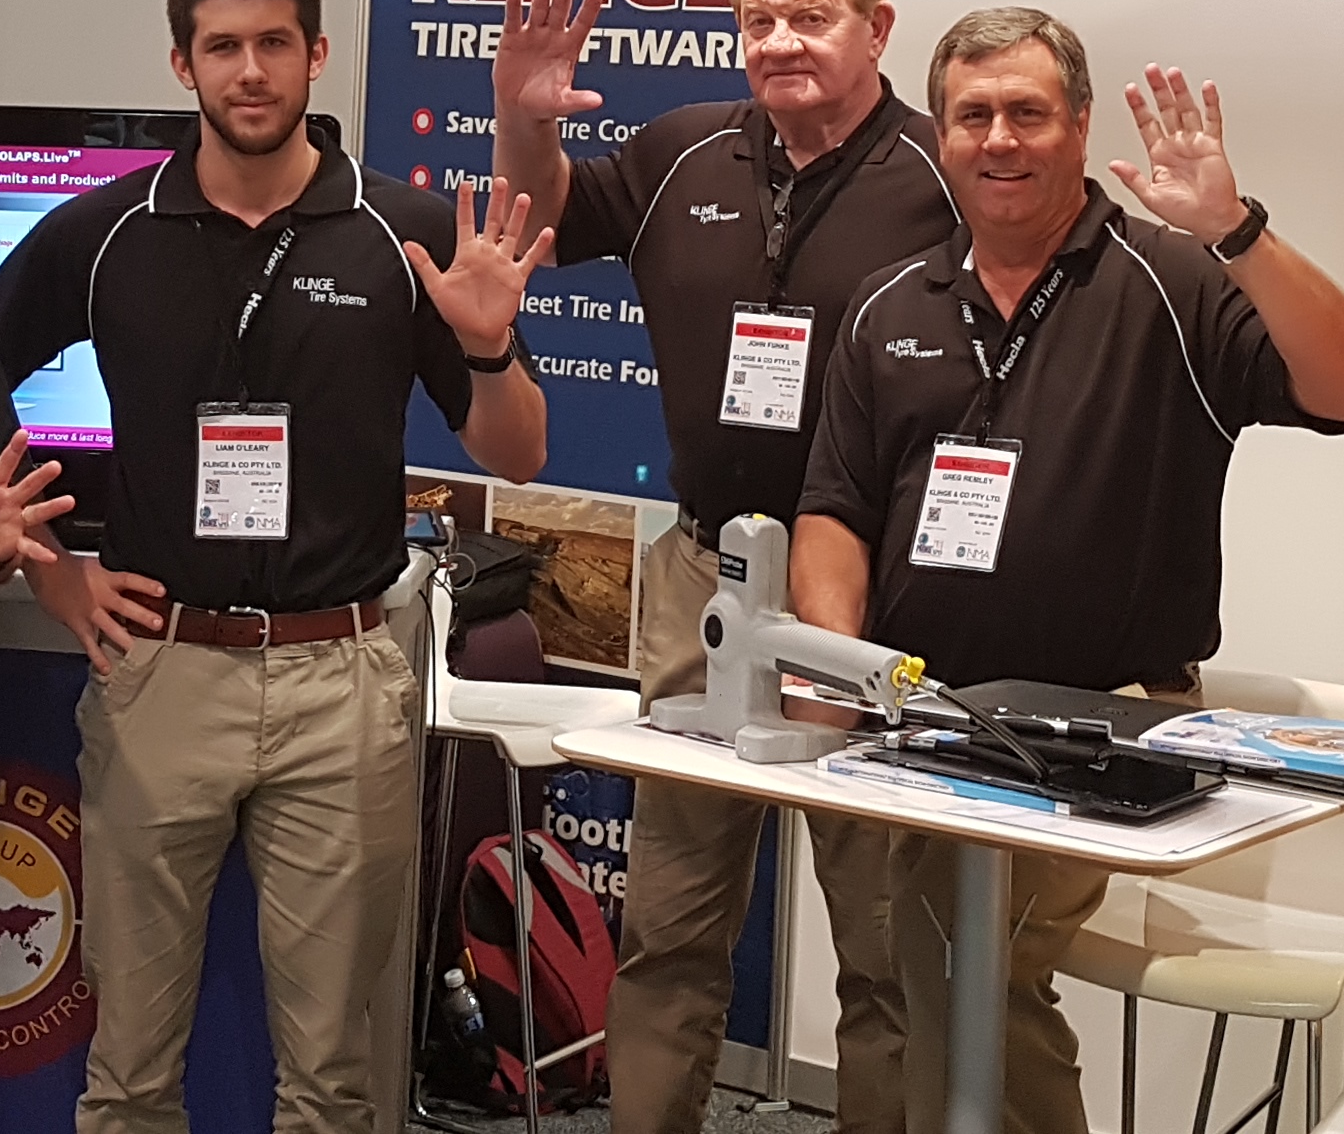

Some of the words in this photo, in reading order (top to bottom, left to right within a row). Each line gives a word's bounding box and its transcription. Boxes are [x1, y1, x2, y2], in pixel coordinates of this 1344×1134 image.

[410, 21, 498, 60] TIRE
[578, 28, 746, 69] FTWAR
[598, 118, 648, 143] Cos
[31, 173, 57, 185] and
[60, 174, 117, 187] Product
[279, 227, 296, 249] 125
[263, 245, 285, 277] Years
[292, 276, 336, 292] KLINGE
[1028, 296, 1046, 320] 125
[1042, 268, 1064, 300] Years
[309, 291, 326, 303] Tire
[328, 292, 368, 307] Systems
[569, 295, 612, 321] Tire
[531, 354, 613, 381] curate
[995, 335, 1027, 380] Hecla
[47, 433, 68, 441] more
[70, 432, 77, 441] &
[78, 433, 94, 442] last
[215, 444, 235, 452] LIAM
[236, 444, 270, 452] O'LEARY
